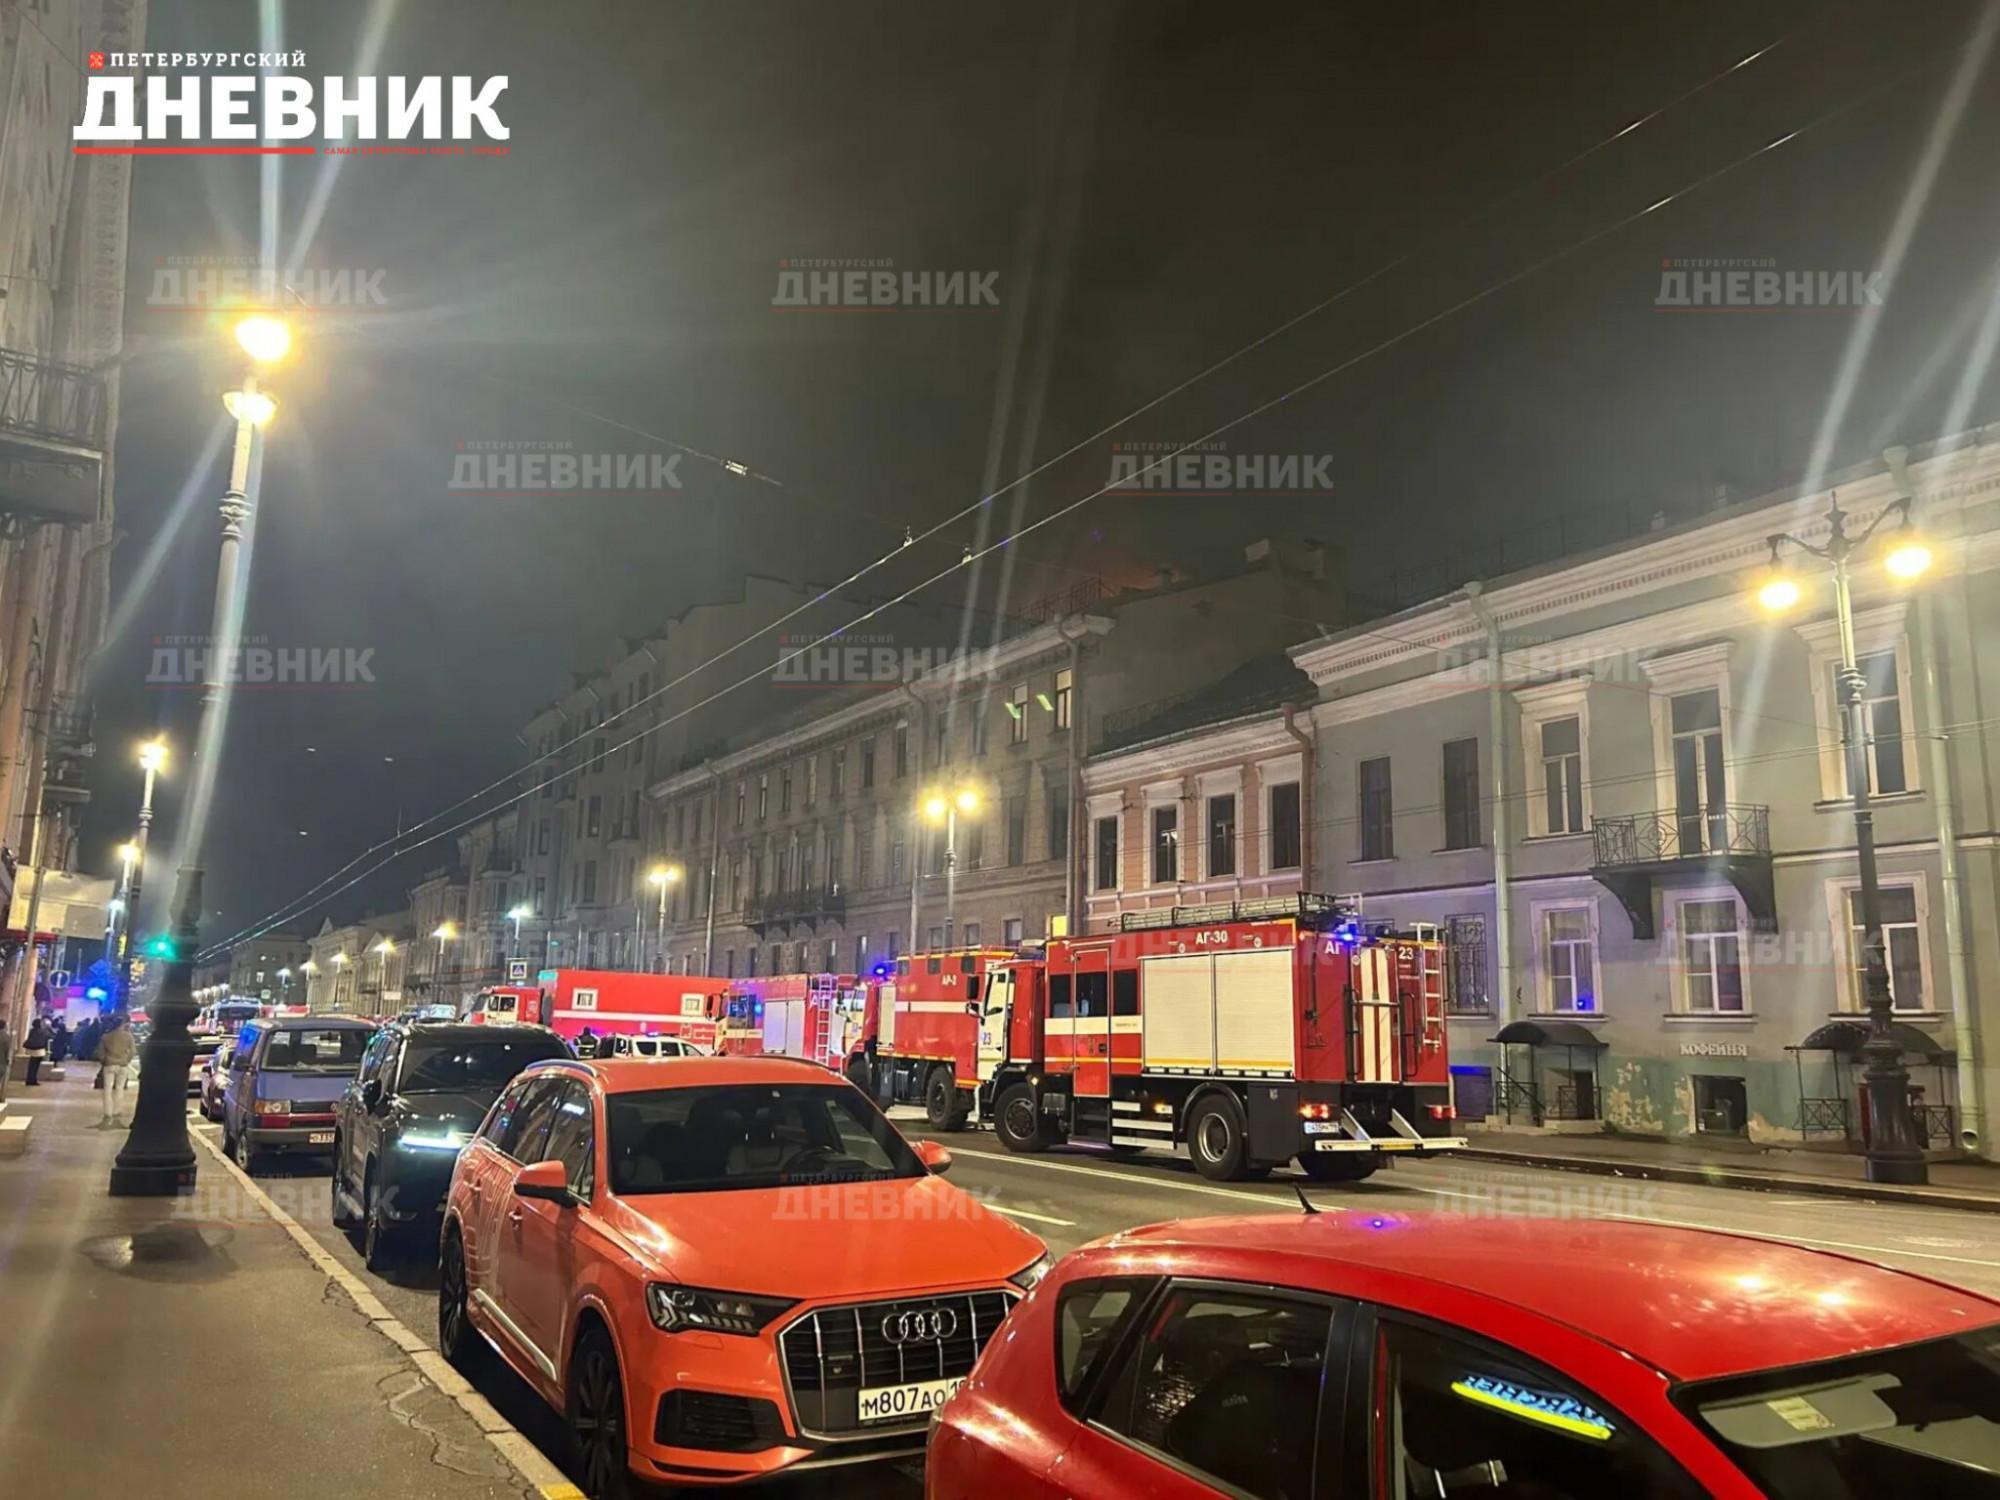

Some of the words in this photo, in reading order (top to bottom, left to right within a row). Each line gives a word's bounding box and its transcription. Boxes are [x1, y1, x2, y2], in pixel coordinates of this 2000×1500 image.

[1195, 930, 1228, 945] АГ-30
[1325, 941, 1344, 955] АГ
[1399, 947, 1414, 960] 23
[1680, 1041, 1748, 1057] КОФЕЙНЯ
[864, 1387, 946, 1417] М807АО
